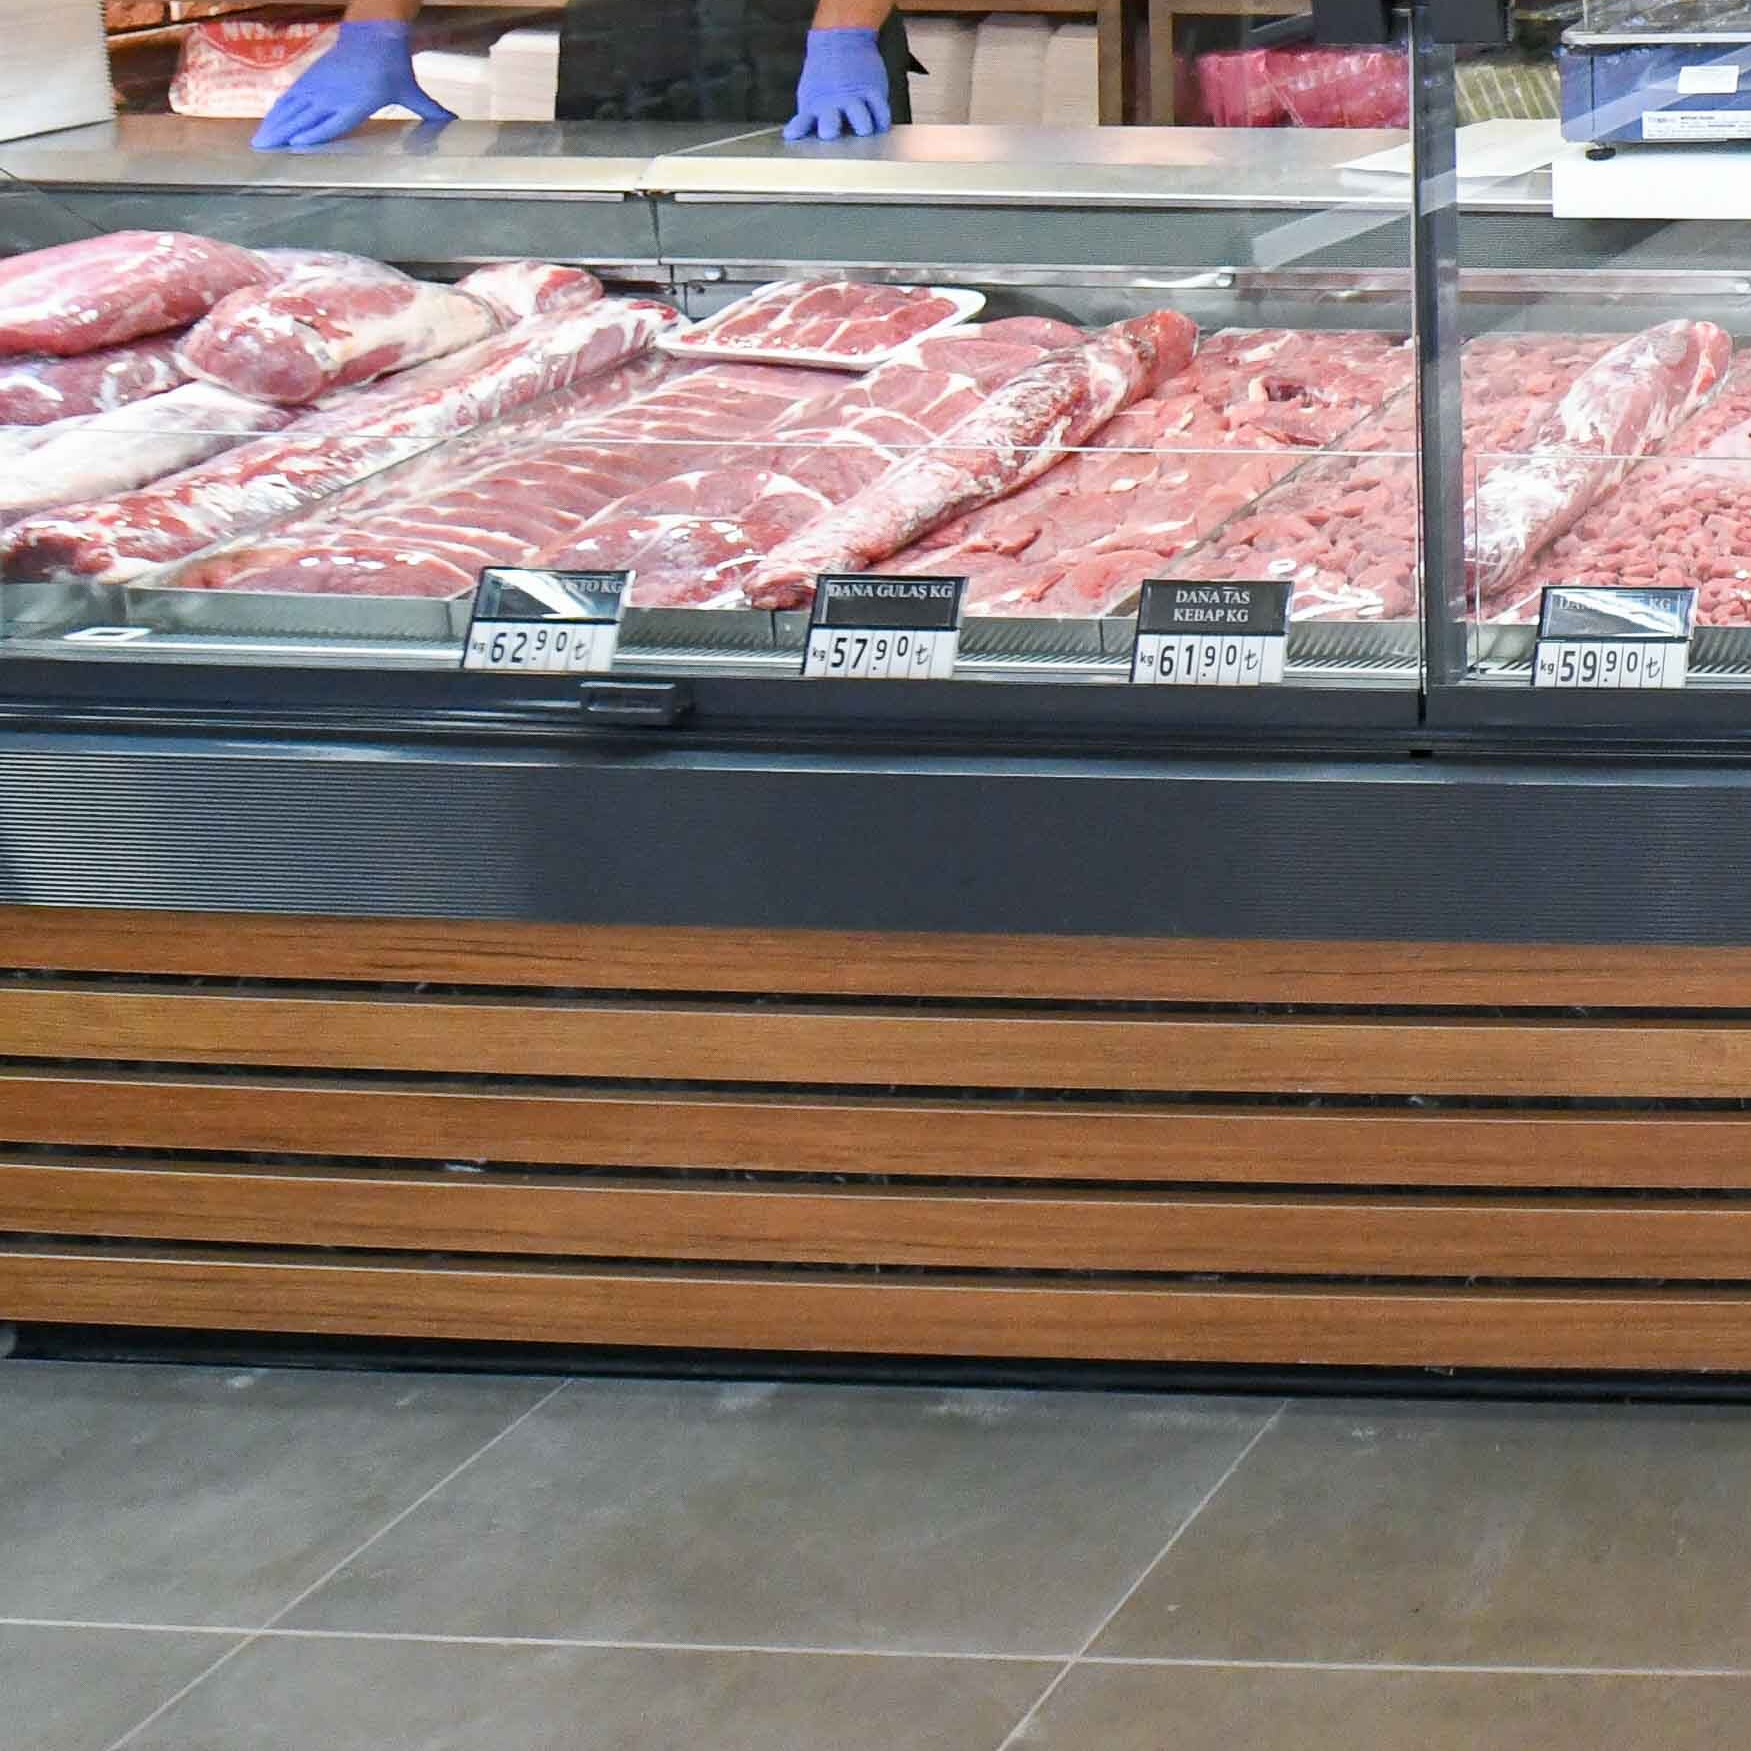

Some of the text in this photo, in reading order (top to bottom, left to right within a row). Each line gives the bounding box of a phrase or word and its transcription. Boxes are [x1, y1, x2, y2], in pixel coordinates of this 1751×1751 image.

[828, 584, 873, 598] DANA
[930, 585, 953, 599] KG
[1175, 590, 1221, 604] DANA
[1173, 609, 1250, 623] KEBAP KG
[831, 636, 910, 671] 57.90
[1140, 652, 1155, 667] kg
[1159, 644, 1238, 678] 61.90
[1540, 659, 1555, 675] kg
[1560, 650, 1639, 683] 59.90
